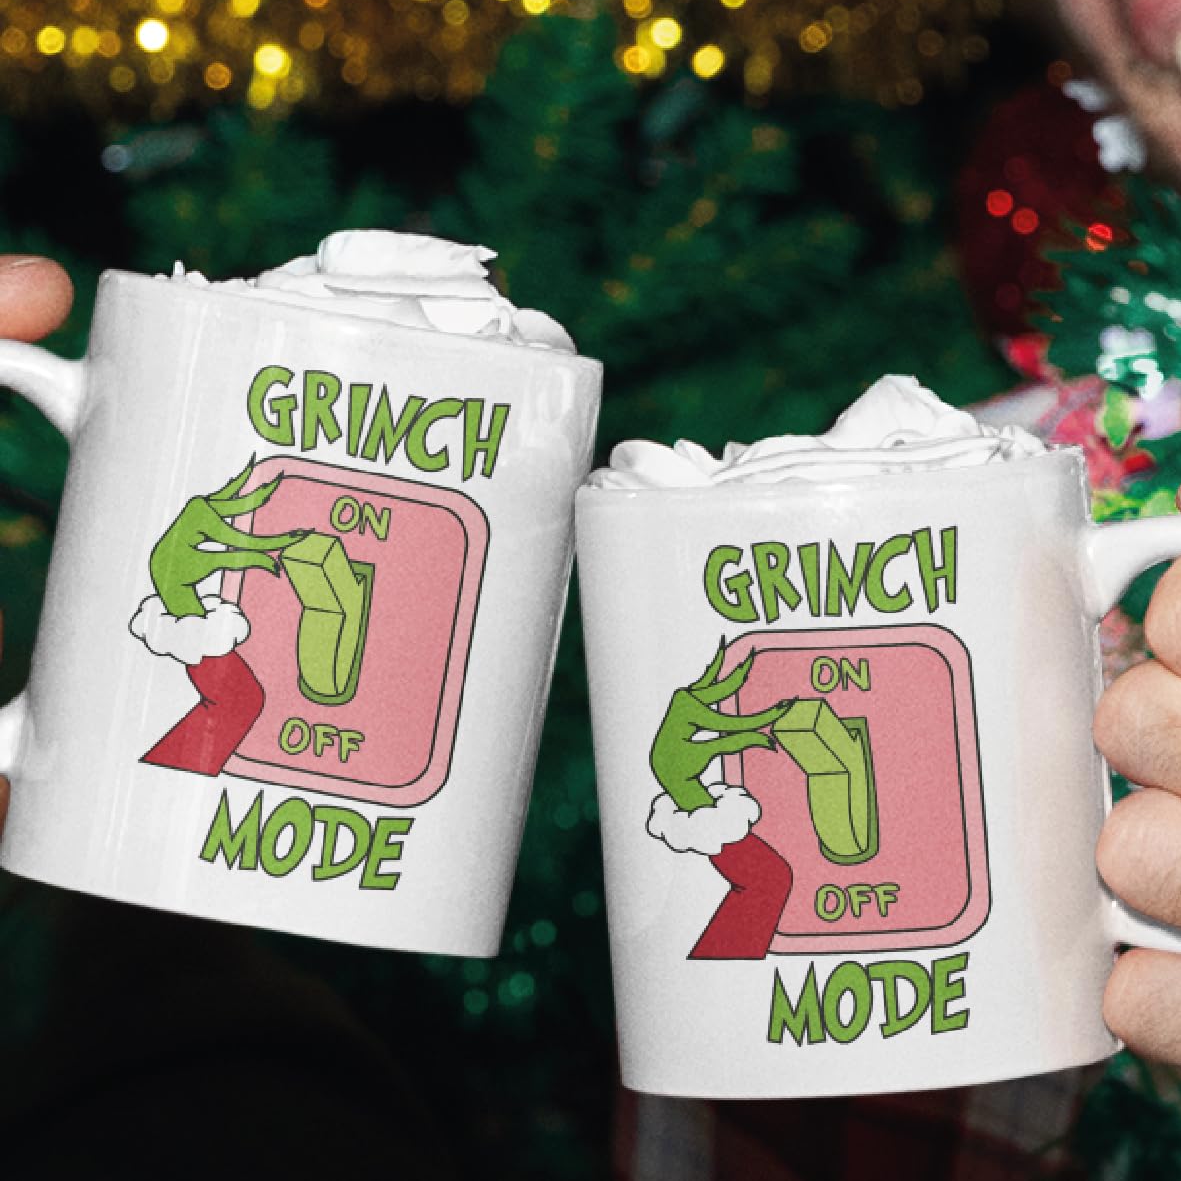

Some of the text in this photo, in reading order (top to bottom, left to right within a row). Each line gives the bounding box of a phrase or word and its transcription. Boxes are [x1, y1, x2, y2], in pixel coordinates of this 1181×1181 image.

[247, 365, 511, 482] GRINCH
[329, 495, 391, 541] ON
[703, 525, 958, 624] GRINCH
[810, 656, 871, 692] ON
[278, 717, 365, 763] OFF
[199, 789, 415, 890] MODE
[815, 882, 901, 922] OFF
[767, 952, 970, 1047] MODE
